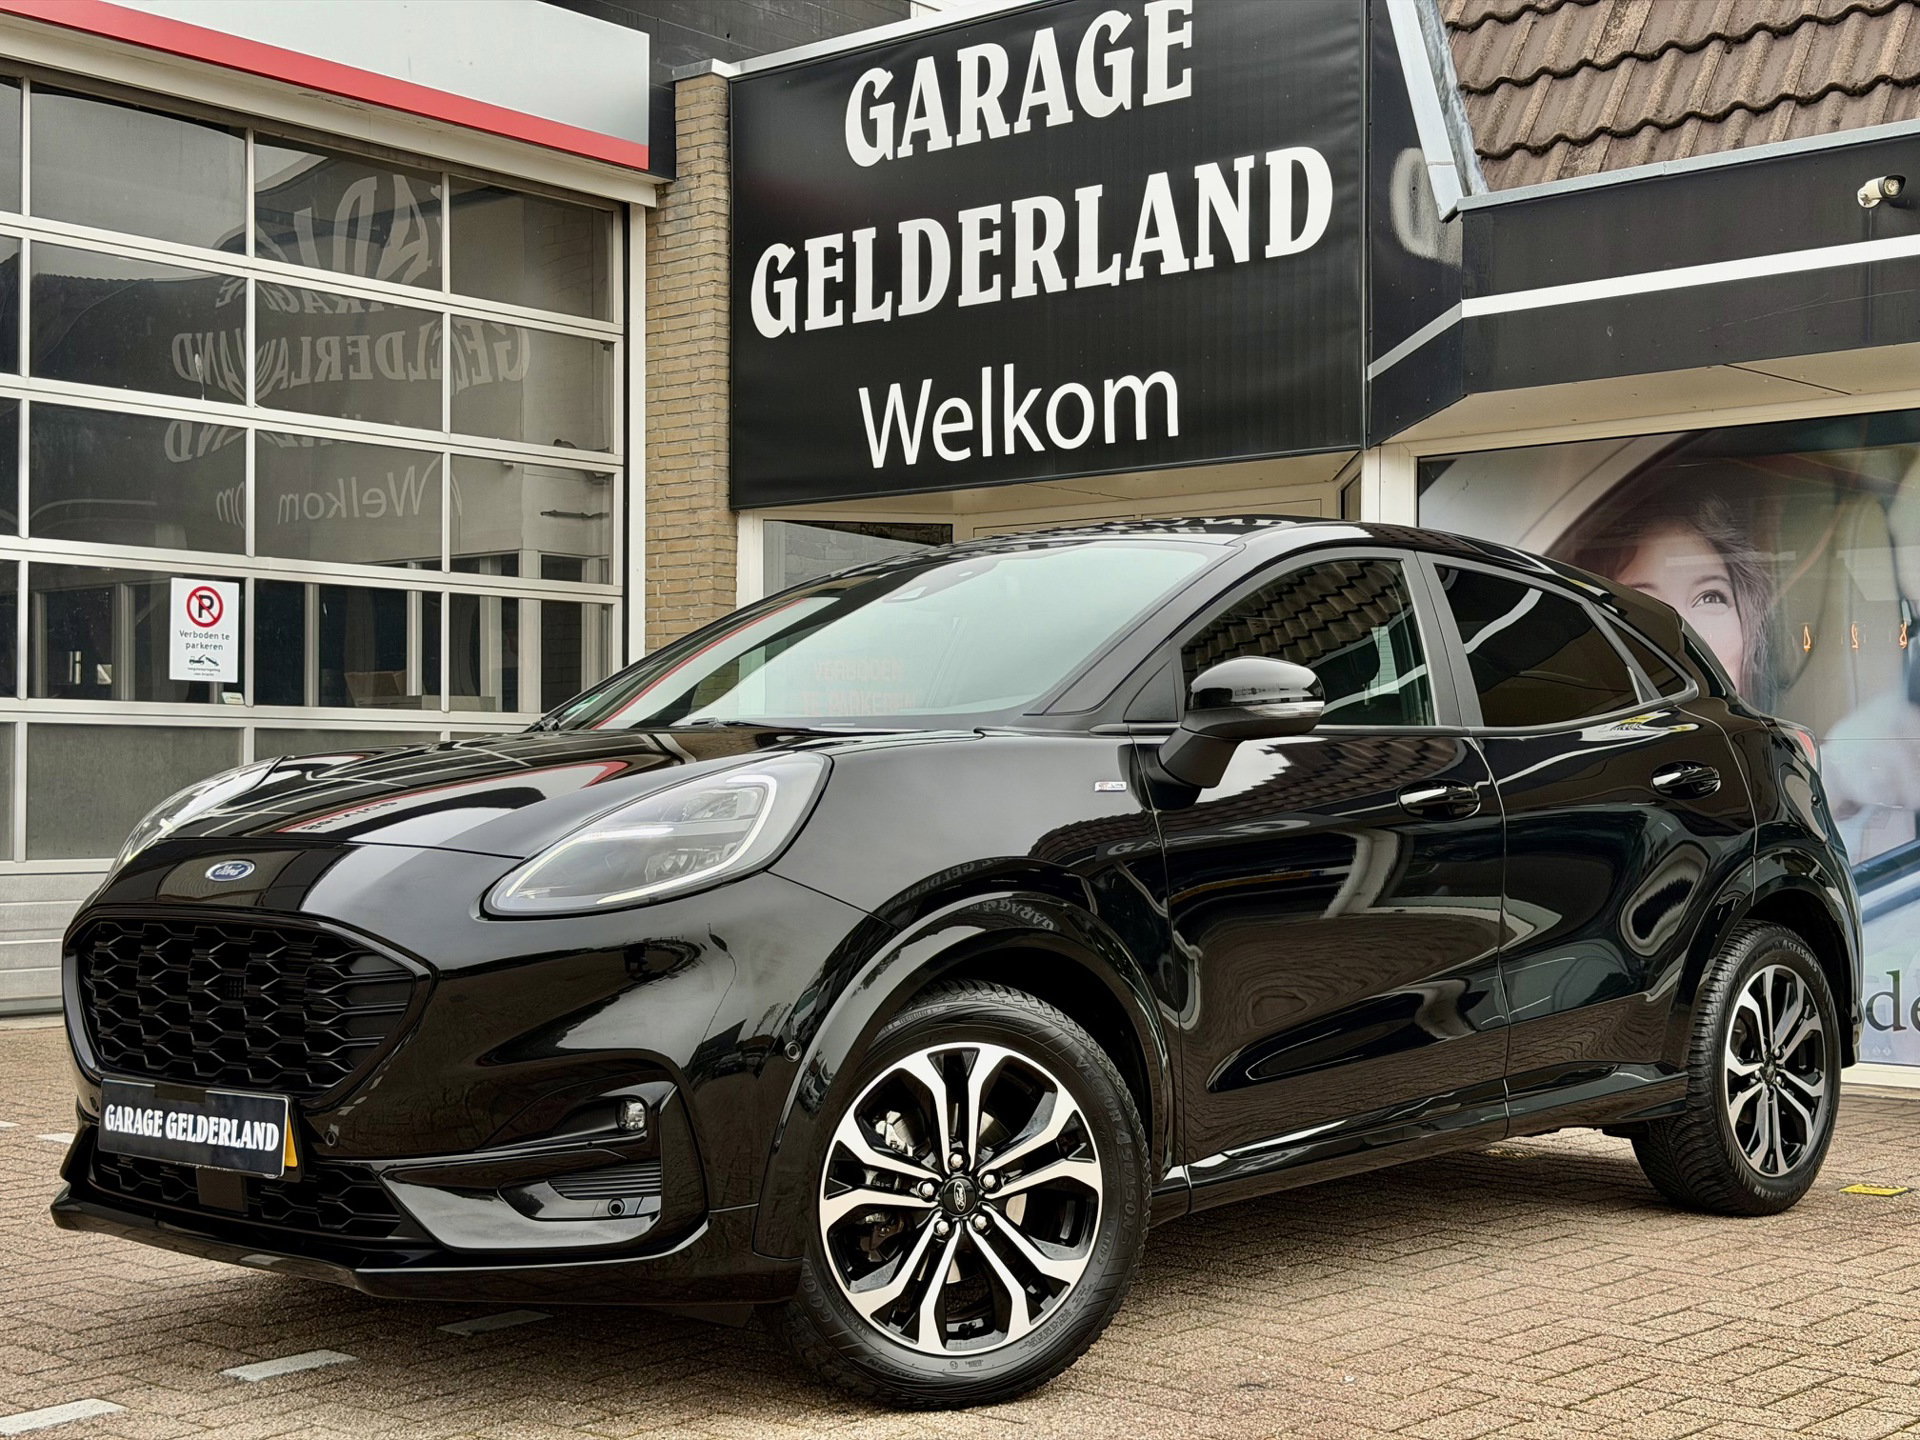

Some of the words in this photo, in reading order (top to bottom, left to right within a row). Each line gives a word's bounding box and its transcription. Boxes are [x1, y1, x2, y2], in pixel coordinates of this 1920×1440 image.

[845, 0, 1192, 168] GARAGE
[751, 147, 1333, 339] GELDERLAND
[859, 364, 1179, 469] Welkom
[179, 629, 219, 640] Verboden
[221, 632, 231, 641] te
[185, 642, 224, 651] parkeren
[104, 1104, 163, 1138] GARAGE
[165, 1111, 280, 1152] GELDERLAND
